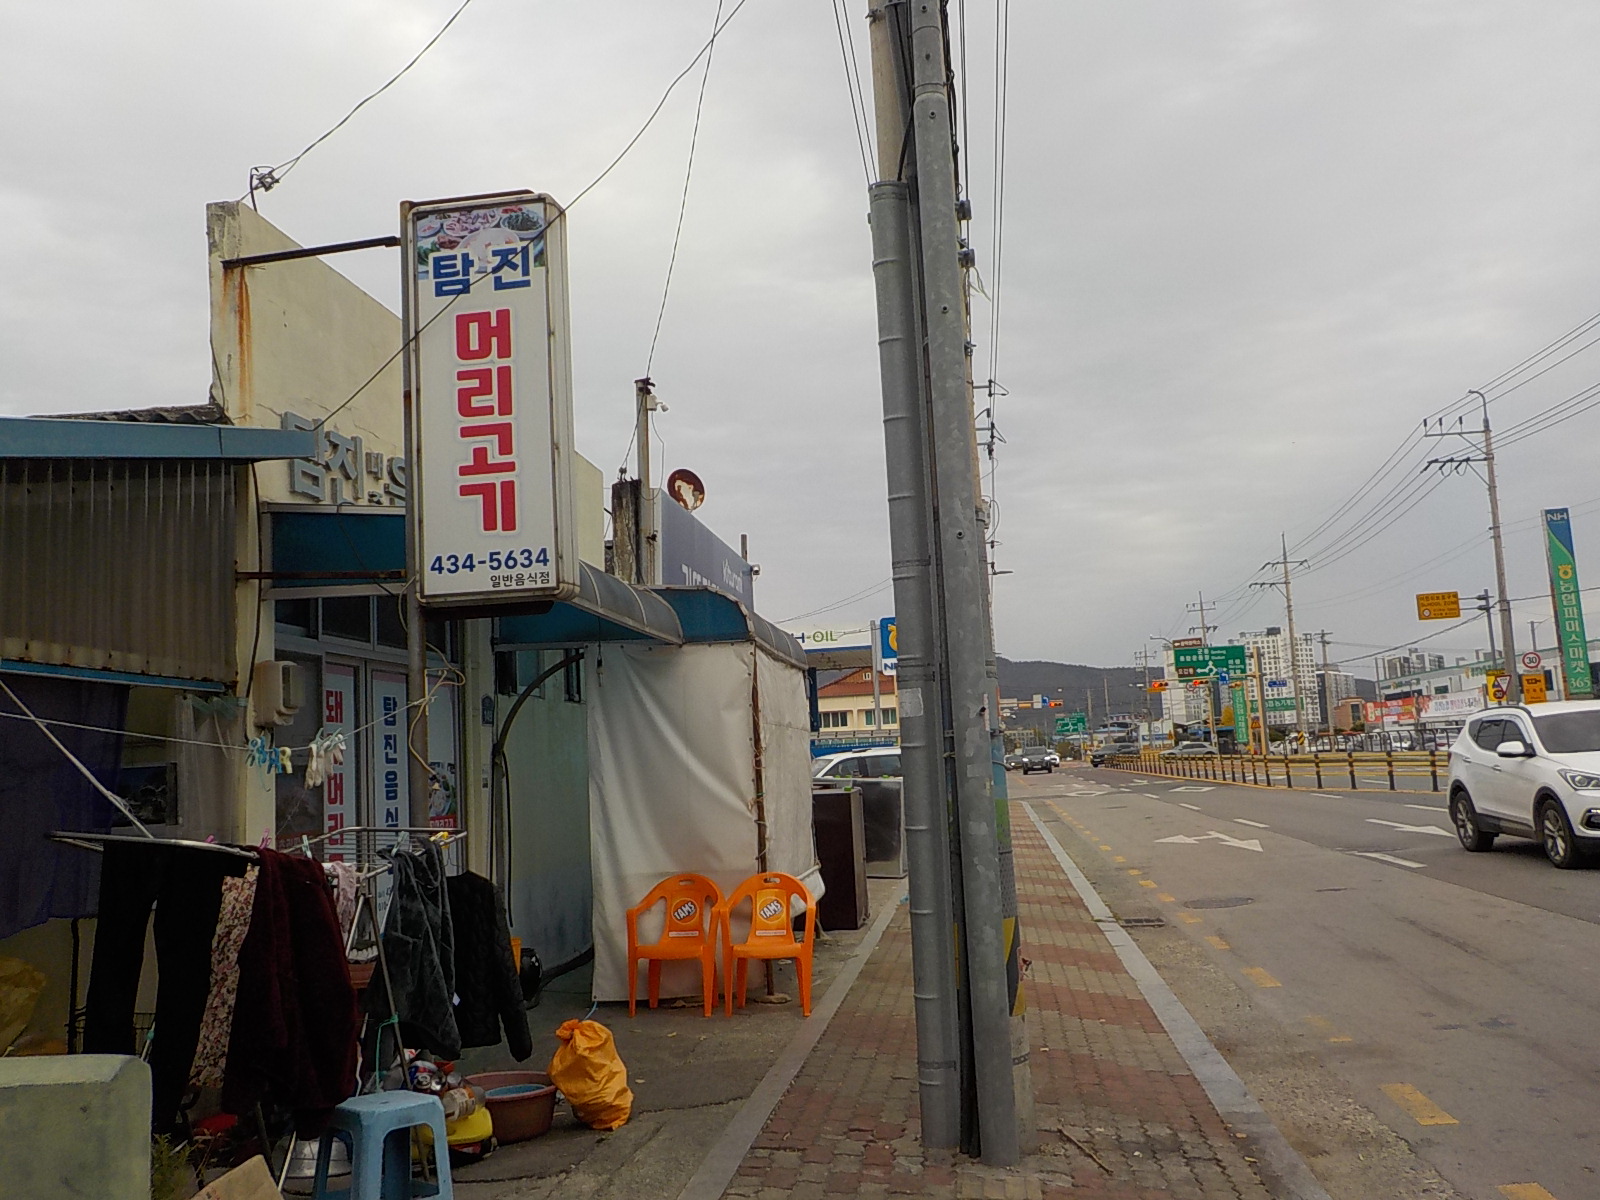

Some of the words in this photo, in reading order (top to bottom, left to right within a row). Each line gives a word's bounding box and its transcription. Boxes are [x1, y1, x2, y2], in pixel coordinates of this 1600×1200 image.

[433, 246, 531, 297] 탐진
[456, 309, 516, 531] 머리고기
[1547, 513, 1567, 521] NH
[430, 548, 550, 574] 434-5634
[490, 571, 550, 588] 일반음식점
[1570, 677, 1590, 688] 365
[673, 901, 695, 920] TAMS
[760, 900, 781, 918] TAMS
